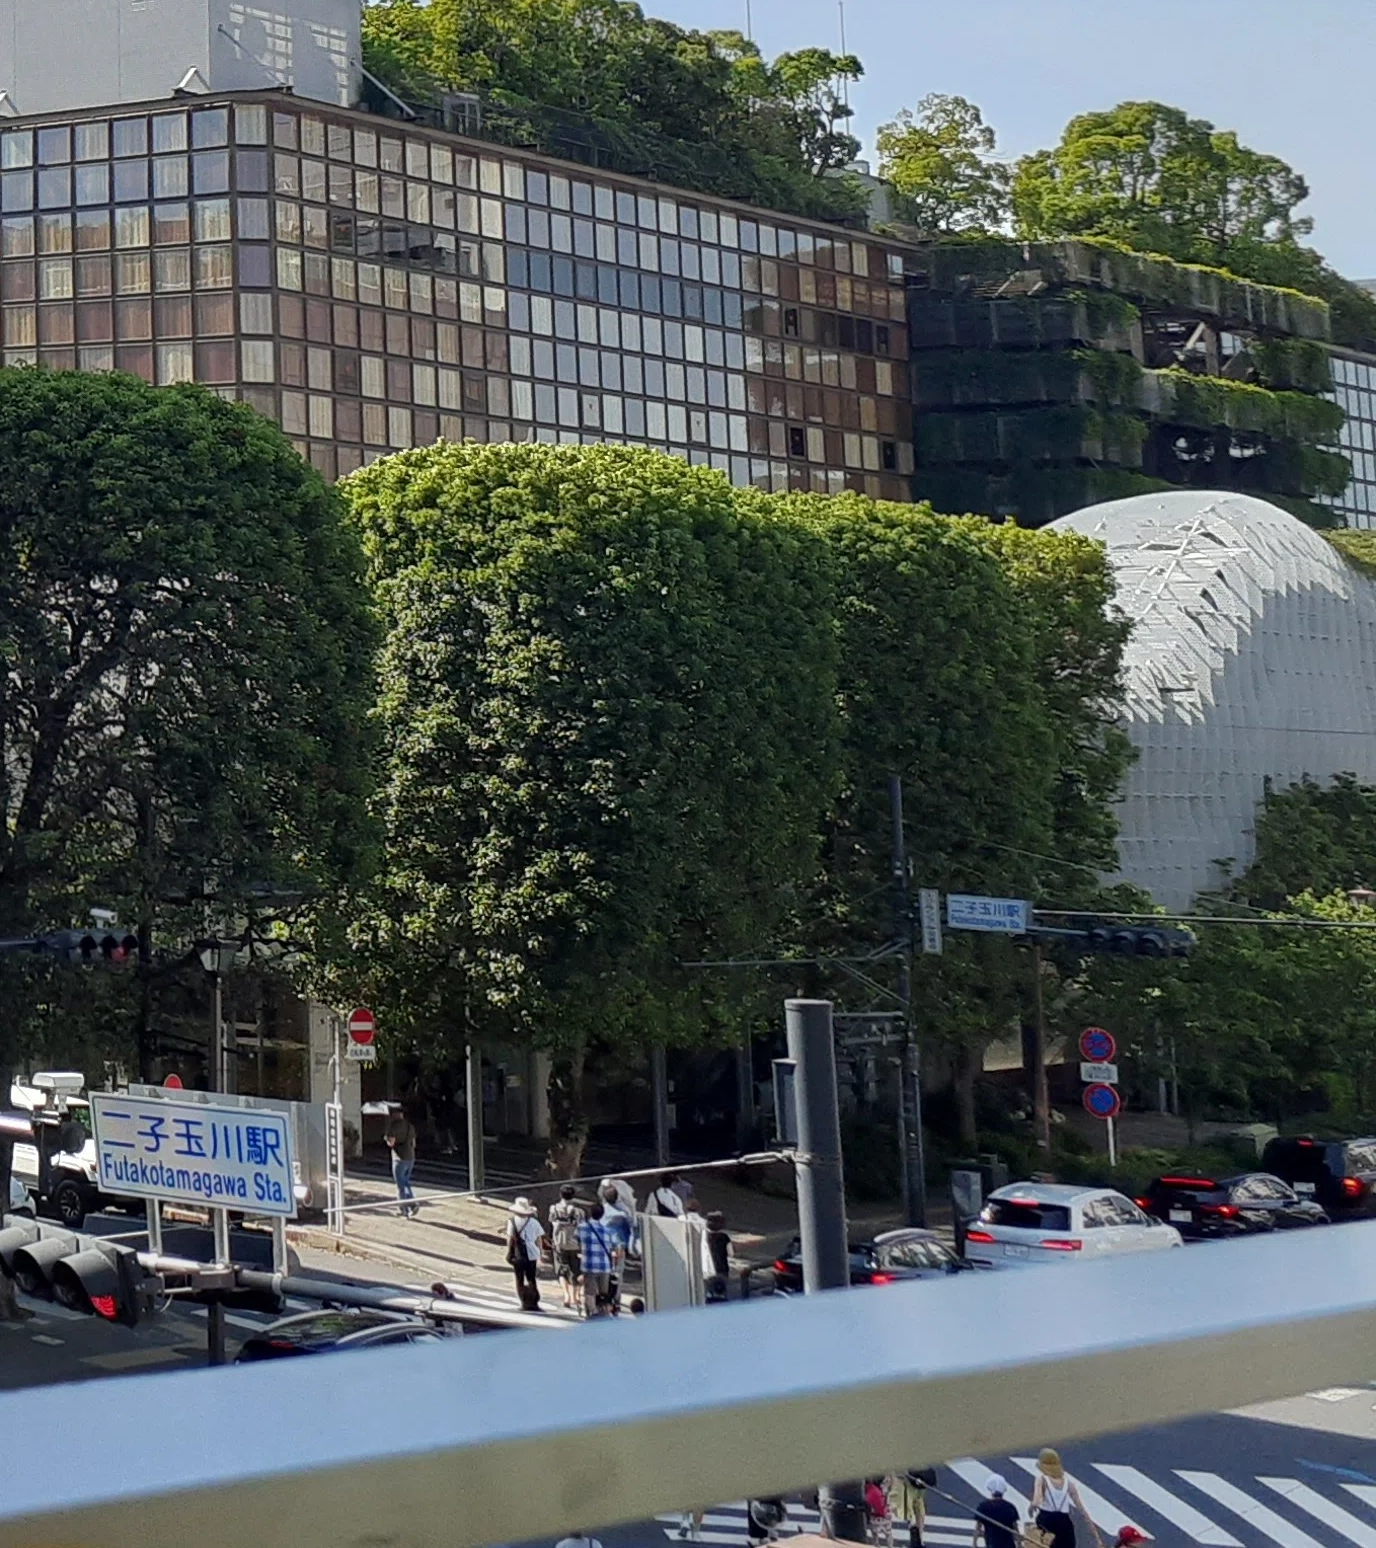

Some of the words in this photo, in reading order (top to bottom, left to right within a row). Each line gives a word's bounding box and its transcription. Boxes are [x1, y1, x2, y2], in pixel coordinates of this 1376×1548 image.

[102, 1111, 284, 1168] 二子玉川駅
[103, 1153, 247, 1198] Futakotamagawa
[253, 1172, 287, 1203] Sta.
